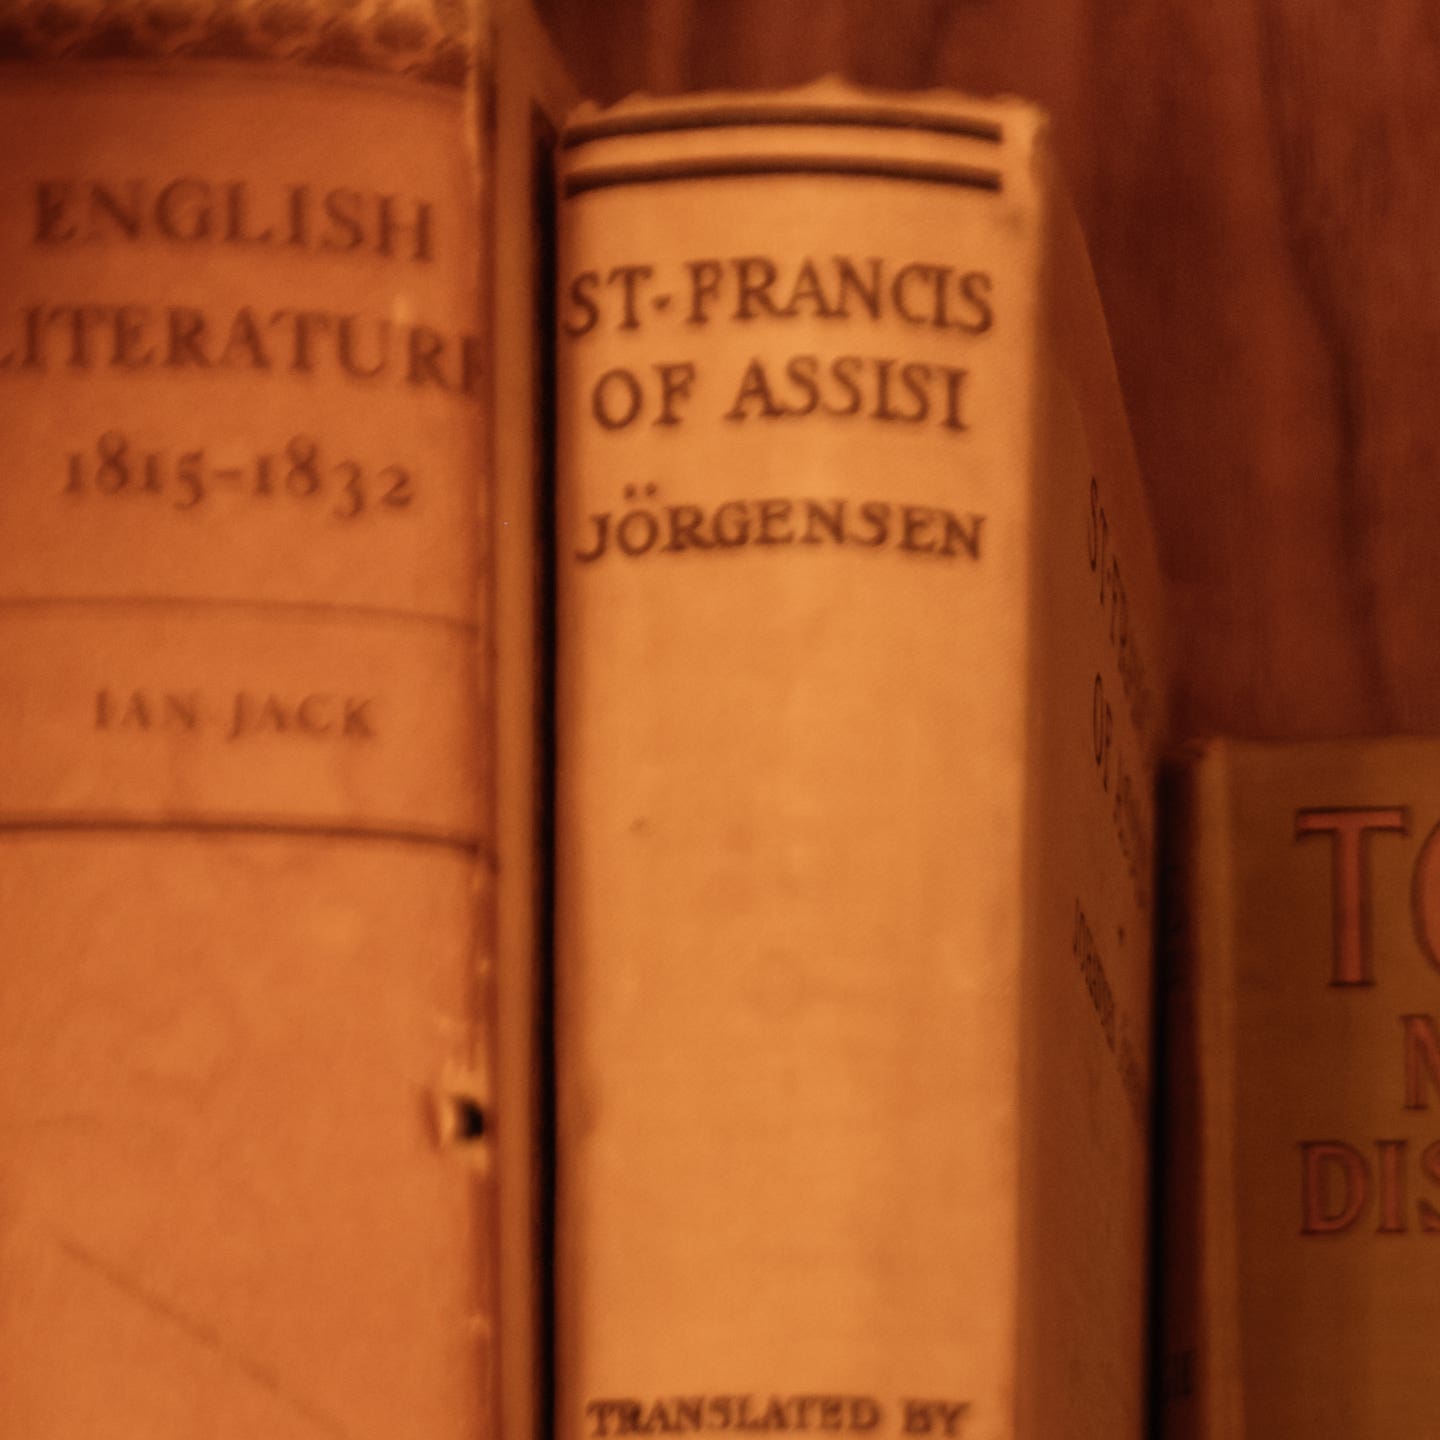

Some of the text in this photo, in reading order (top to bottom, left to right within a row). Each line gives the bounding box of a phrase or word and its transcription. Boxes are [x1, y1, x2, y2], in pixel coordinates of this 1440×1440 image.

[28, 176, 436, 264] ENGLISH
[590, 355, 971, 433] OF ASSISI
[573, 482, 987, 564] JÖRGENSEN
[93, 690, 378, 744] IAN JACK
[587, 1396, 881, 1440] TRANSLATED
